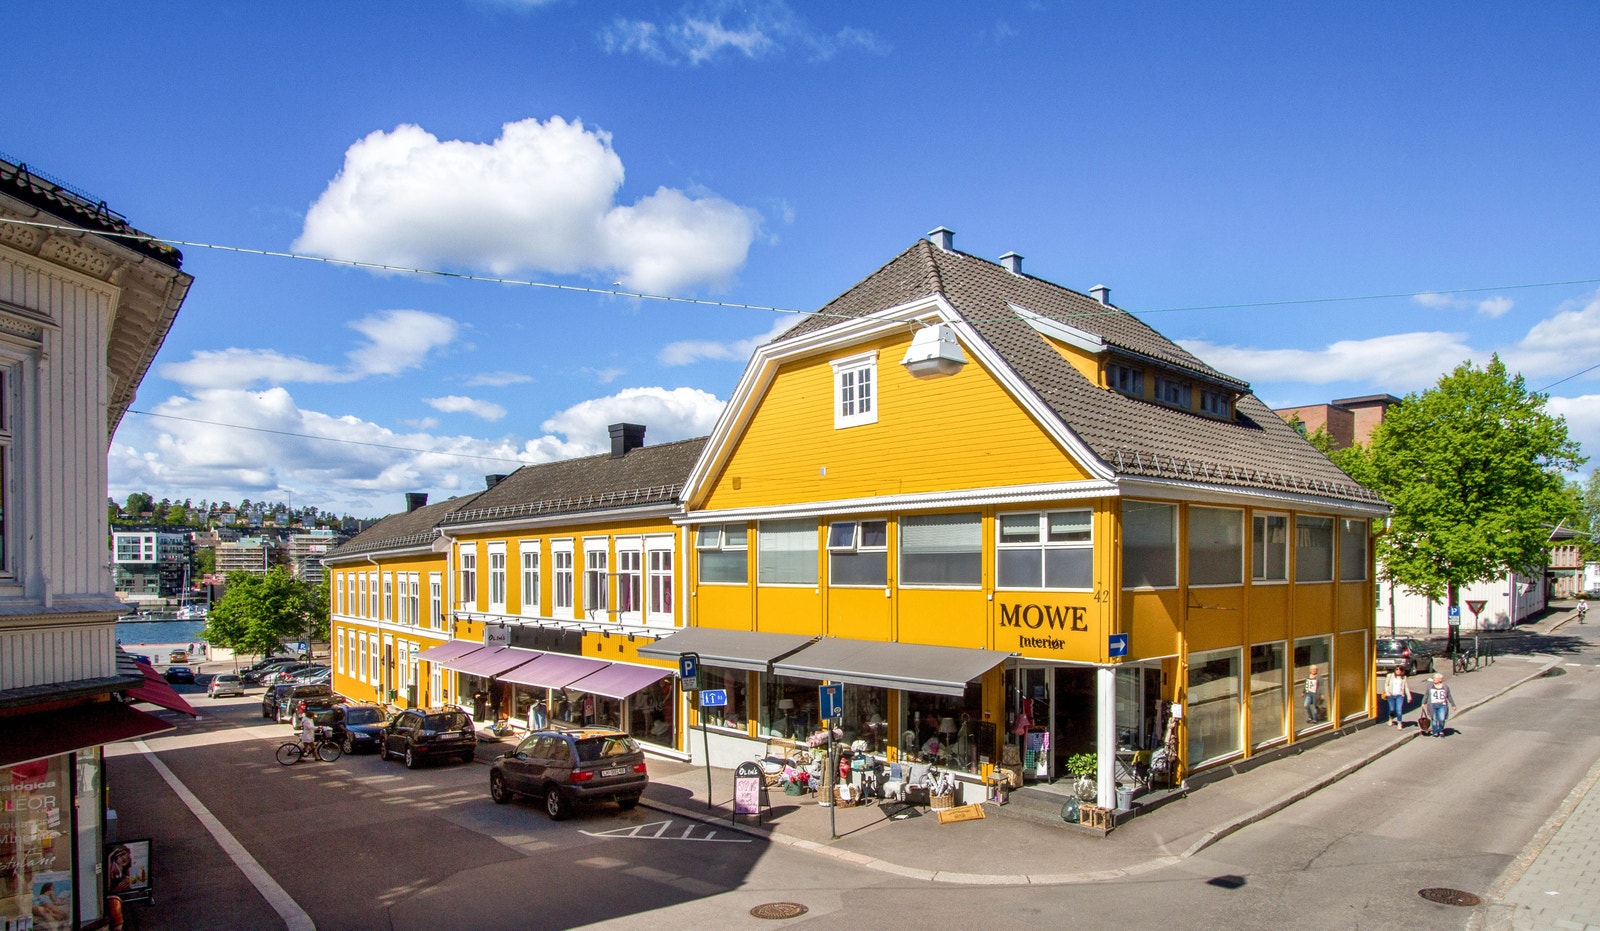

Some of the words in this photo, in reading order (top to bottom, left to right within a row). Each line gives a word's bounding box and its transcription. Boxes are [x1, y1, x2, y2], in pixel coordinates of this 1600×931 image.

[1094, 589, 1109, 603] 42
[1000, 603, 1088, 632] MOWE
[1019, 635, 1065, 651] Interiør
[684, 660, 693, 676] P
